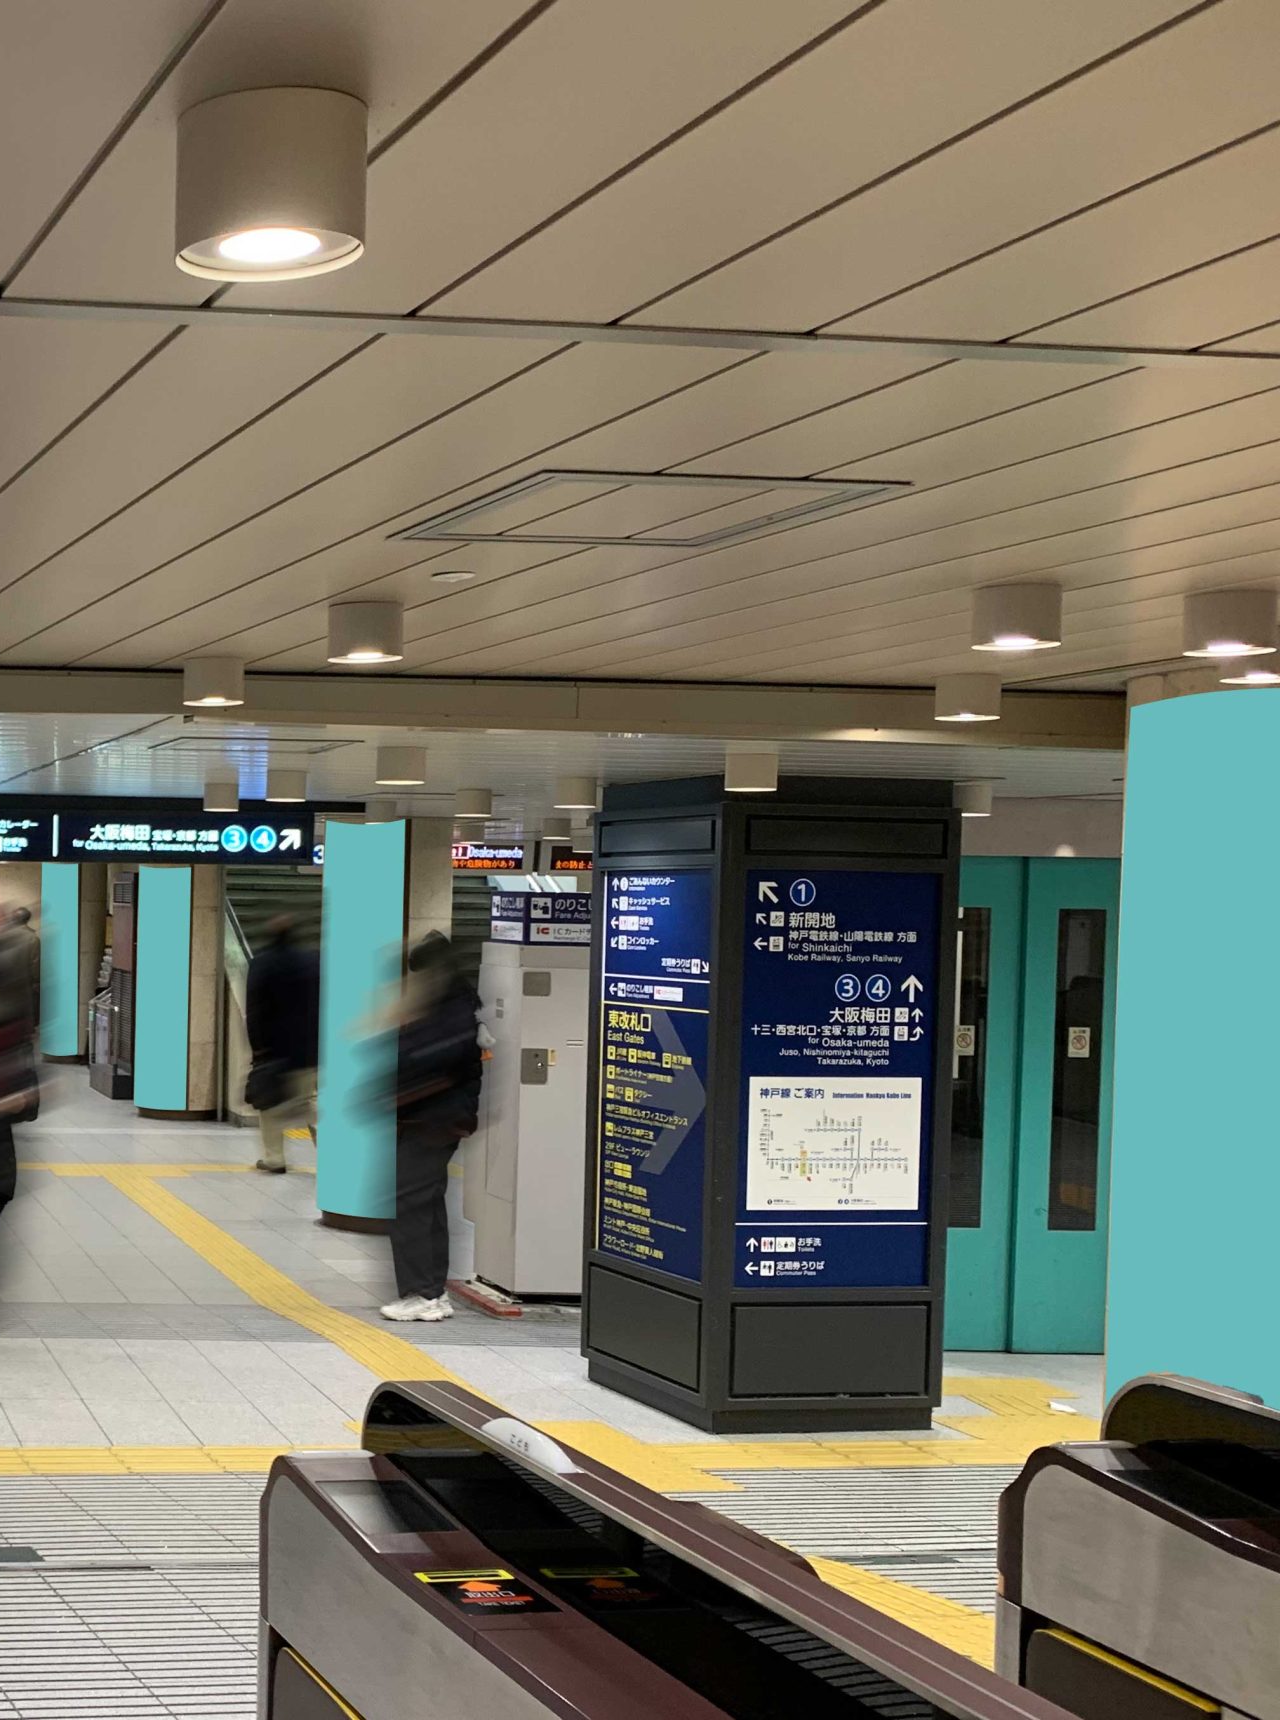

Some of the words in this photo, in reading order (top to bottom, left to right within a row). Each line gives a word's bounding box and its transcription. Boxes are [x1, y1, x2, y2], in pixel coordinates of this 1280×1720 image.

[89, 824, 151, 842] 大阪梅田
[788, 911, 836, 929] 新開地
[536, 927, 550, 935] IC
[788, 930, 894, 942] 神戸電鉄線・山陽電鉄線
[897, 931, 917, 943] 方面
[788, 942, 799, 950] for
[802, 943, 853, 953] Shinkaichi
[787, 953, 809, 962] Kobe
[810, 953, 844, 963] Railway,
[846, 954, 871, 964] Sanyo
[872, 955, 904, 965] Railway
[608, 1010, 652, 1032] 東改札口
[829, 1006, 891, 1024] 大阪梅田
[751, 1024, 867, 1036] 十三・西宮北口・宝塚・京都
[870, 1025, 890, 1037] 方面
[607, 1030, 623, 1042] East
[624, 1032, 645, 1045] Gates
[808, 1037, 819, 1045] for
[822, 1037, 890, 1048] Osaka-umeda
[778, 1048, 801, 1057] Juso,
[803, 1048, 890, 1058] Nishinomiya-kitaguchi
[817, 1057, 864, 1067] Takarazuka,
[866, 1058, 890, 1067] Kyoto
[760, 1088, 791, 1099] 神戸線
[794, 1088, 825, 1099] ご案内
